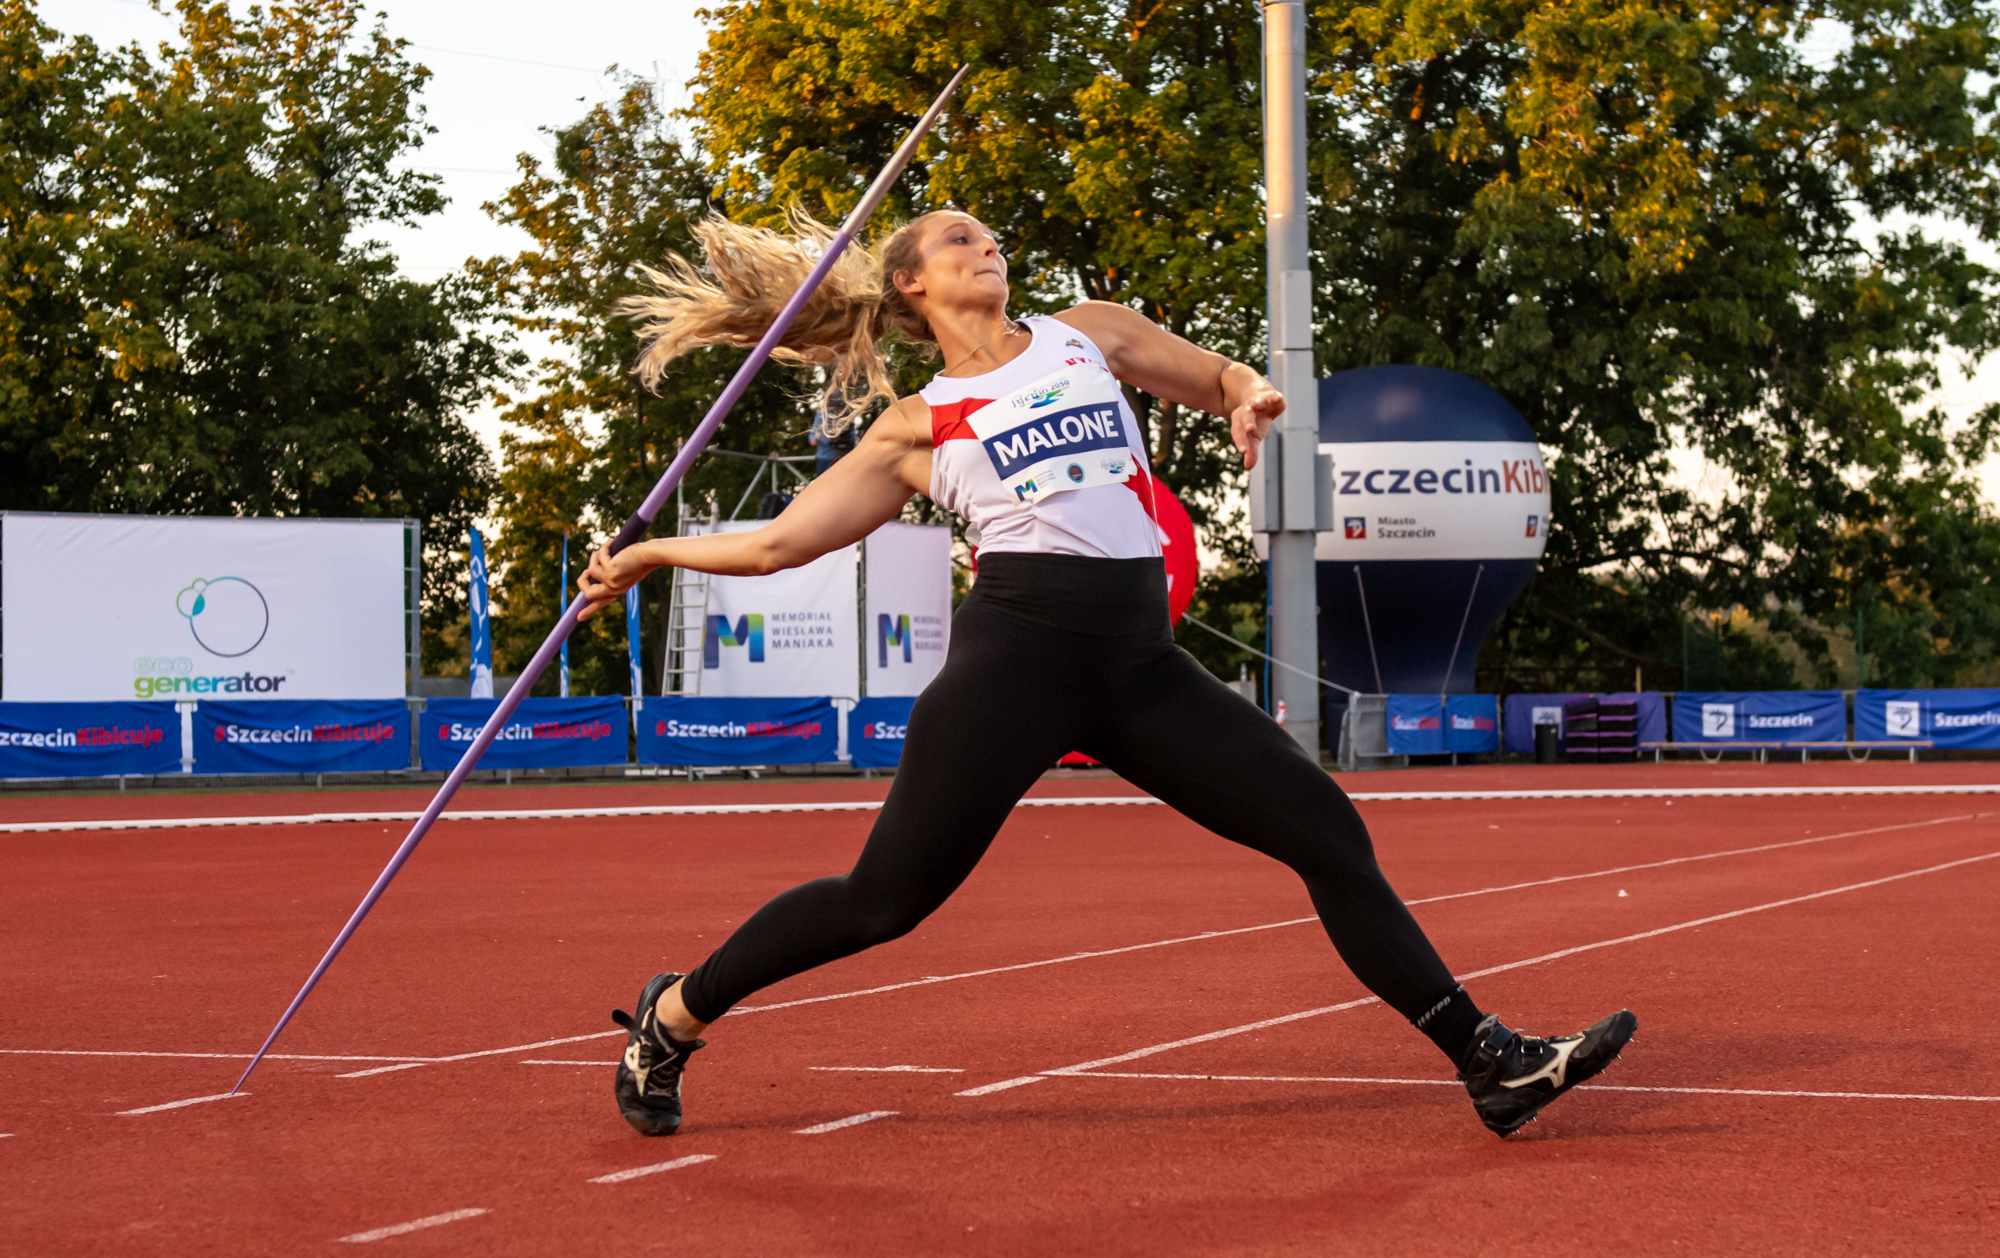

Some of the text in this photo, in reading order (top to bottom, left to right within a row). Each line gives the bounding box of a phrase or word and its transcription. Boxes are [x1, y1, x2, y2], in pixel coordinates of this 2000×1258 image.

[993, 410, 1119, 467] MALONE
[1377, 516, 1416, 526] Miasto
[1377, 527, 1436, 540] Szczecin
[771, 612, 832, 623] MEMORIAŁ
[771, 625, 833, 637] WIESŁAWA
[771, 638, 834, 649] MANIAKA
[134, 672, 286, 699] generator
[1749, 712, 1814, 729] Szczecin
[1935, 710, 2000, 728] Szczecin
[214, 722, 395, 744] #SzczecinKibicuje
[439, 719, 612, 741] #SzcecinKibicuje
[656, 719, 822, 740] #SzczecinKibicuje
